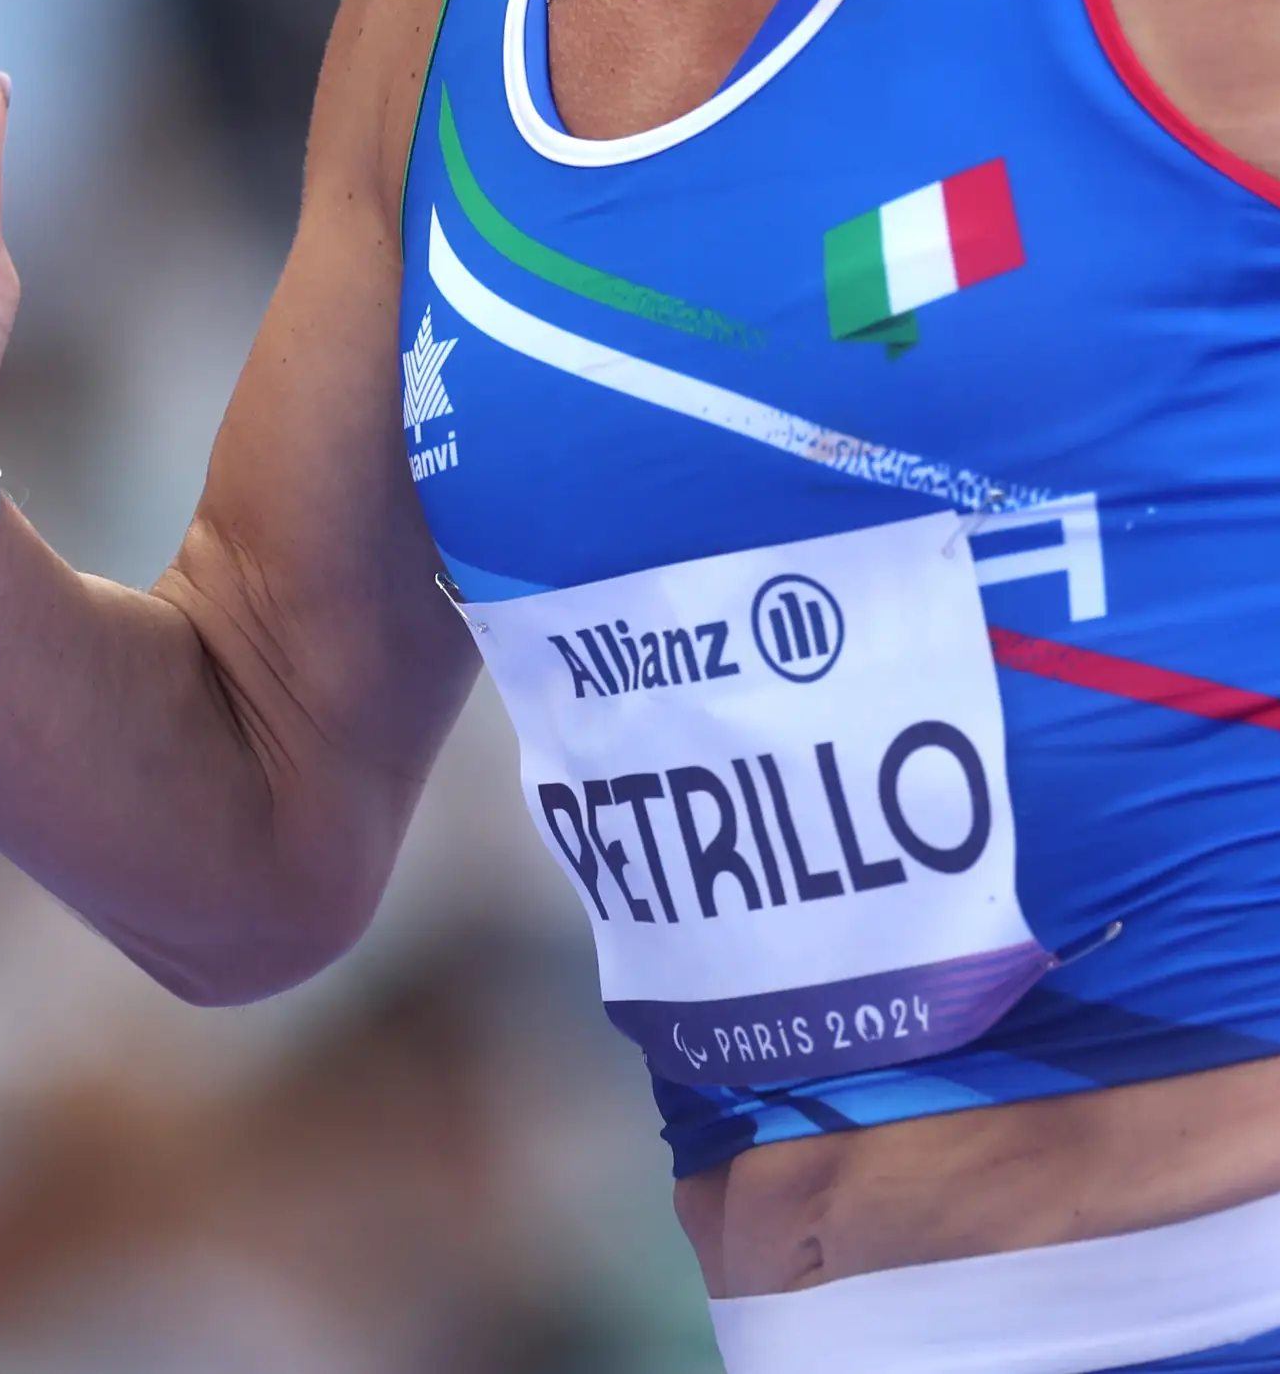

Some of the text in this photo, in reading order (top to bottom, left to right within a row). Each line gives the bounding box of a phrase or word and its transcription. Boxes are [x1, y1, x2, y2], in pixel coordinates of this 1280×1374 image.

[548, 620, 740, 698] Allianz
[537, 720, 992, 925] PETRILLO
[826, 994, 929, 1050] 2024
